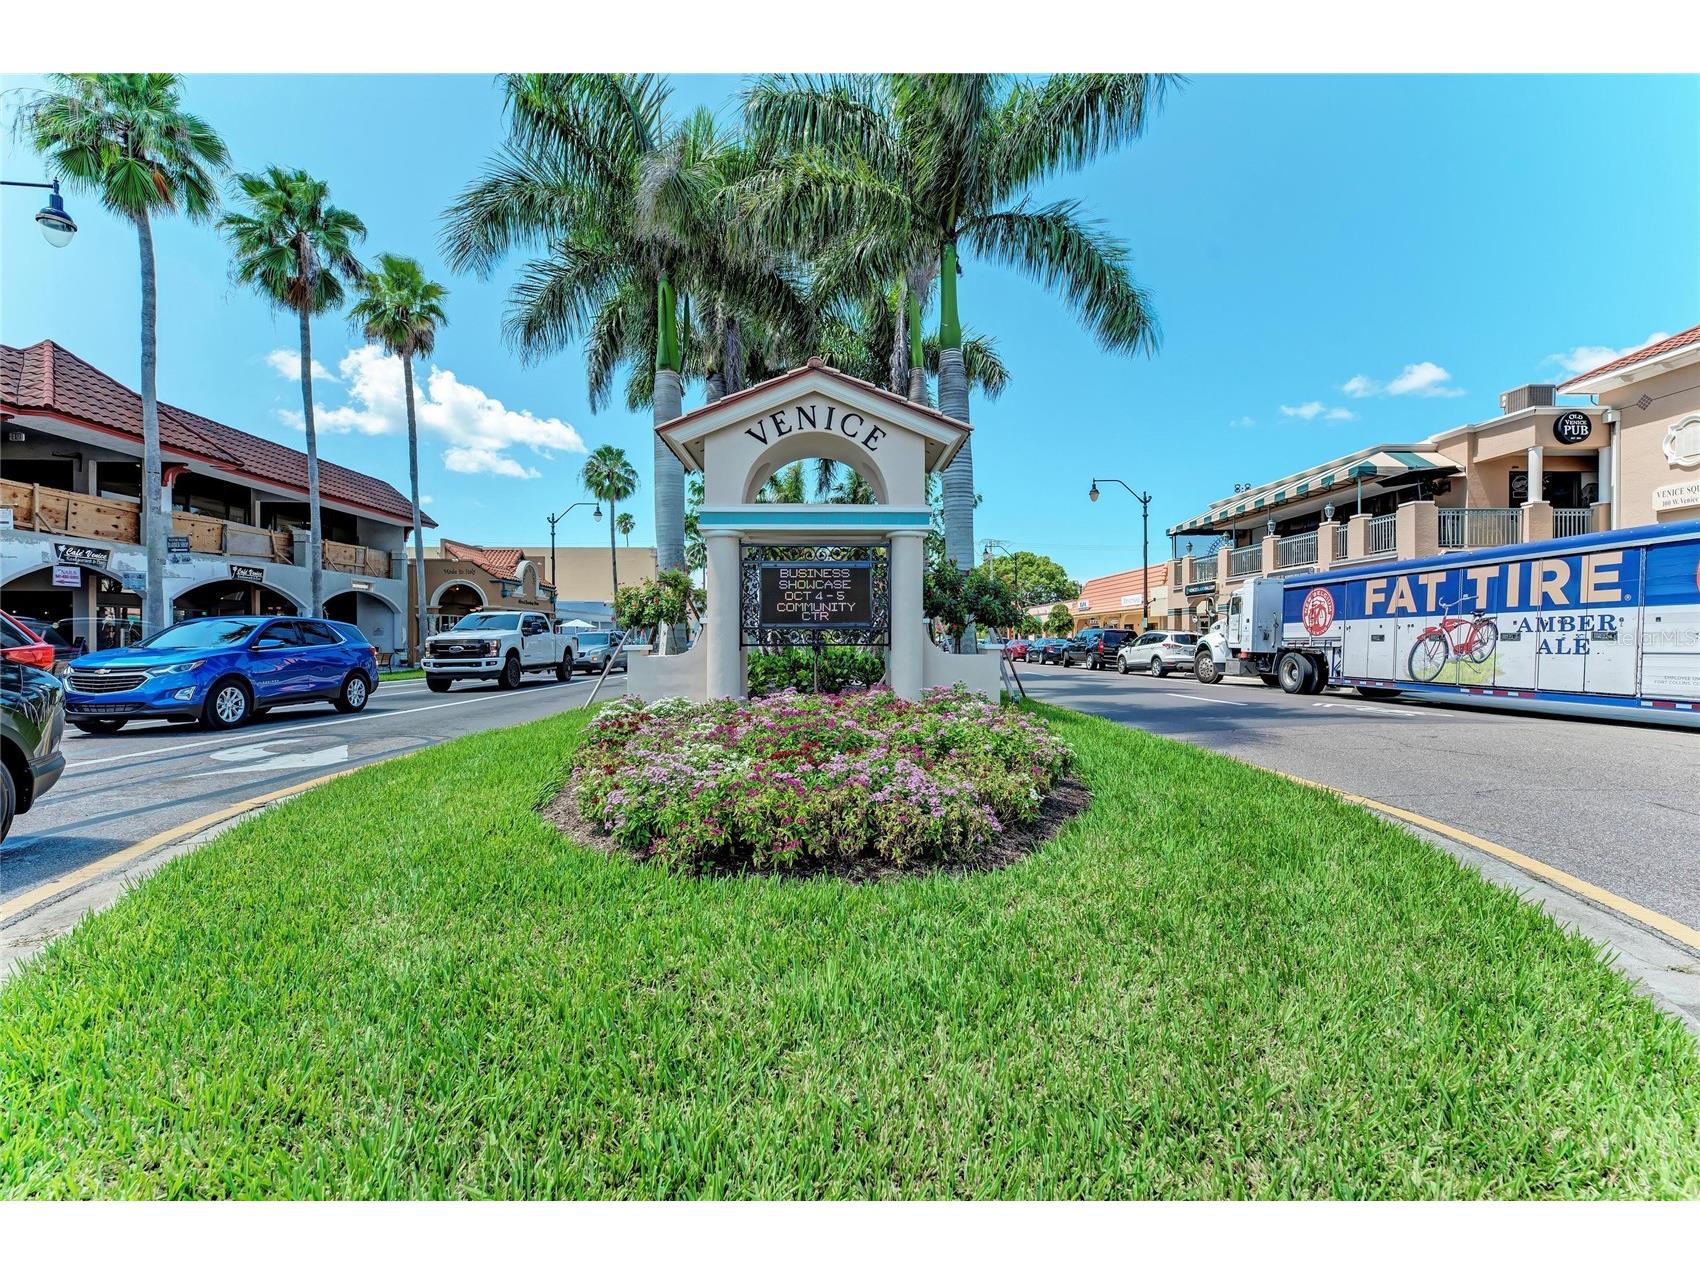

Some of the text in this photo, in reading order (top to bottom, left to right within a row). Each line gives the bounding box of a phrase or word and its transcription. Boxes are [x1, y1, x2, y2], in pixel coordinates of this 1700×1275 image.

[745, 405, 887, 452] VENICE
[1564, 425, 1589, 436] PUB
[1656, 487, 1685, 498] VENICE
[1680, 496, 1699, 504] Venice
[66, 547, 107, 560] Café Venice
[780, 568, 851, 579] BUSINESS
[779, 580, 852, 590] SHOWCASE
[785, 591, 812, 601] OCT
[1365, 572, 1446, 616] FAT
[776, 602, 856, 612] COMMUNITY
[801, 612, 830, 621] CTR
[1516, 614, 1618, 633] AMBER
[1536, 638, 1590, 656] ALE
